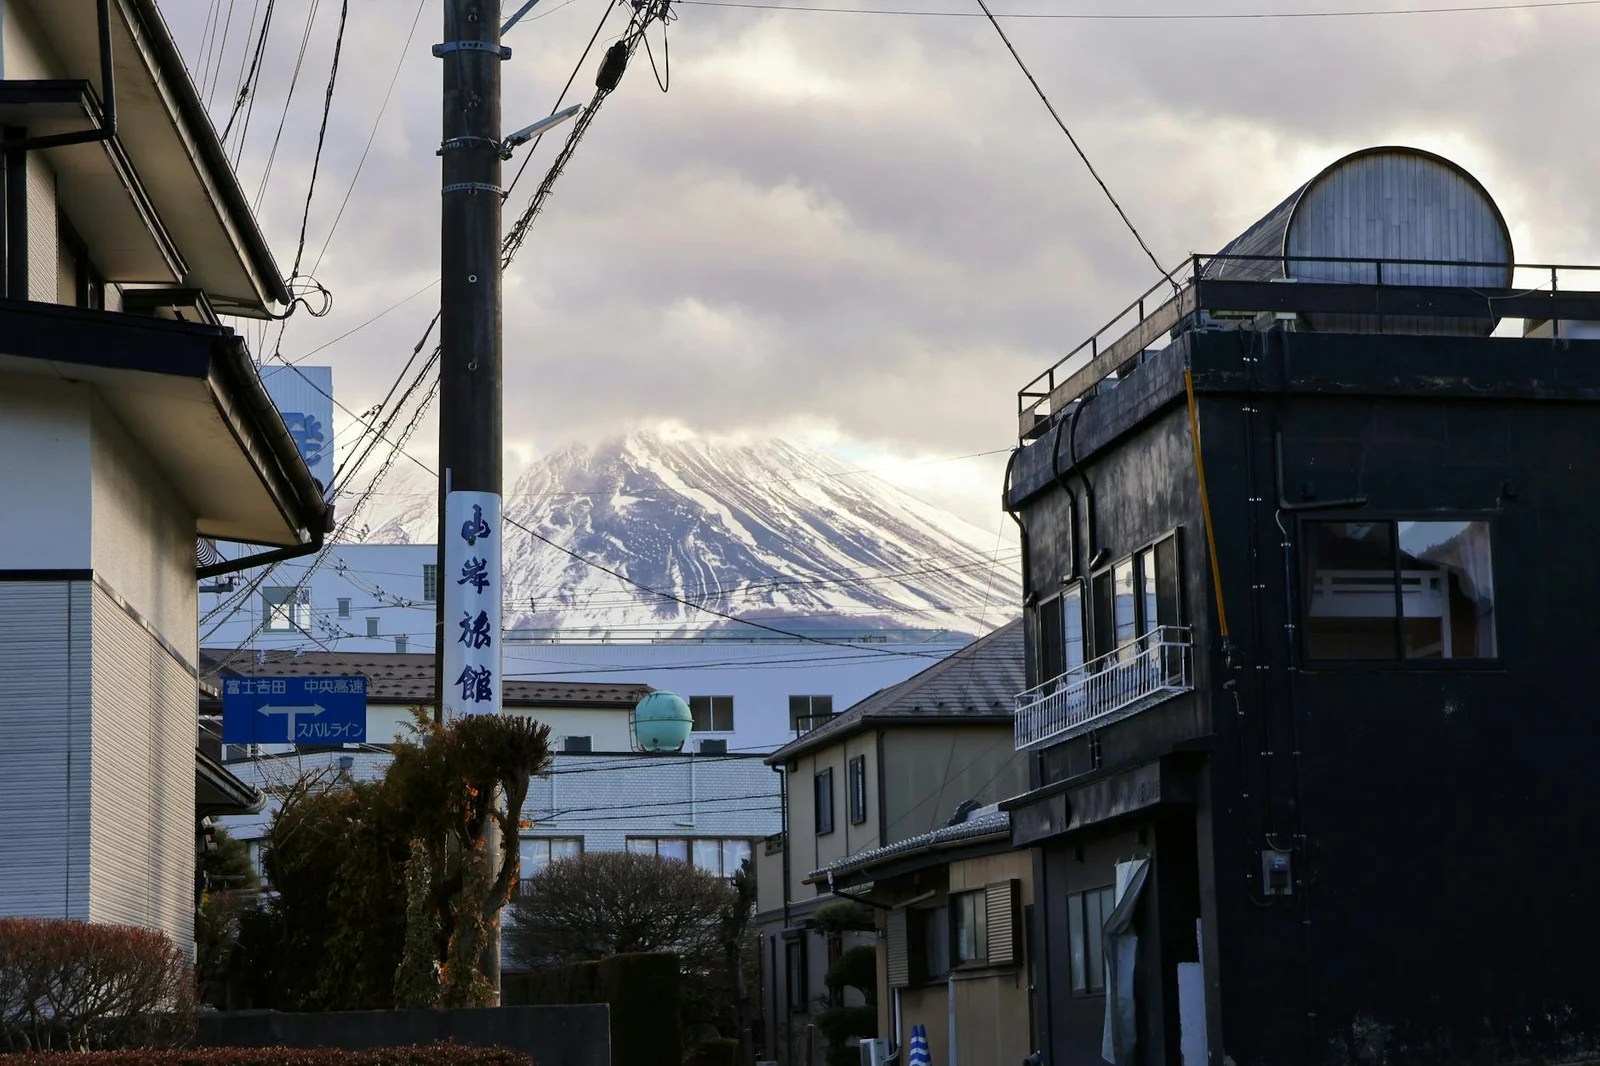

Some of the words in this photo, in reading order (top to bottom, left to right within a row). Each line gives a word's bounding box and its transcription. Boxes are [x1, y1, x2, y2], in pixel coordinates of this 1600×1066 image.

[455, 503, 492, 704] 山岸旅館
[226, 679, 286, 694] 富士吉田
[304, 679, 364, 694] 中央高速
[297, 722, 363, 738] スバルライン
